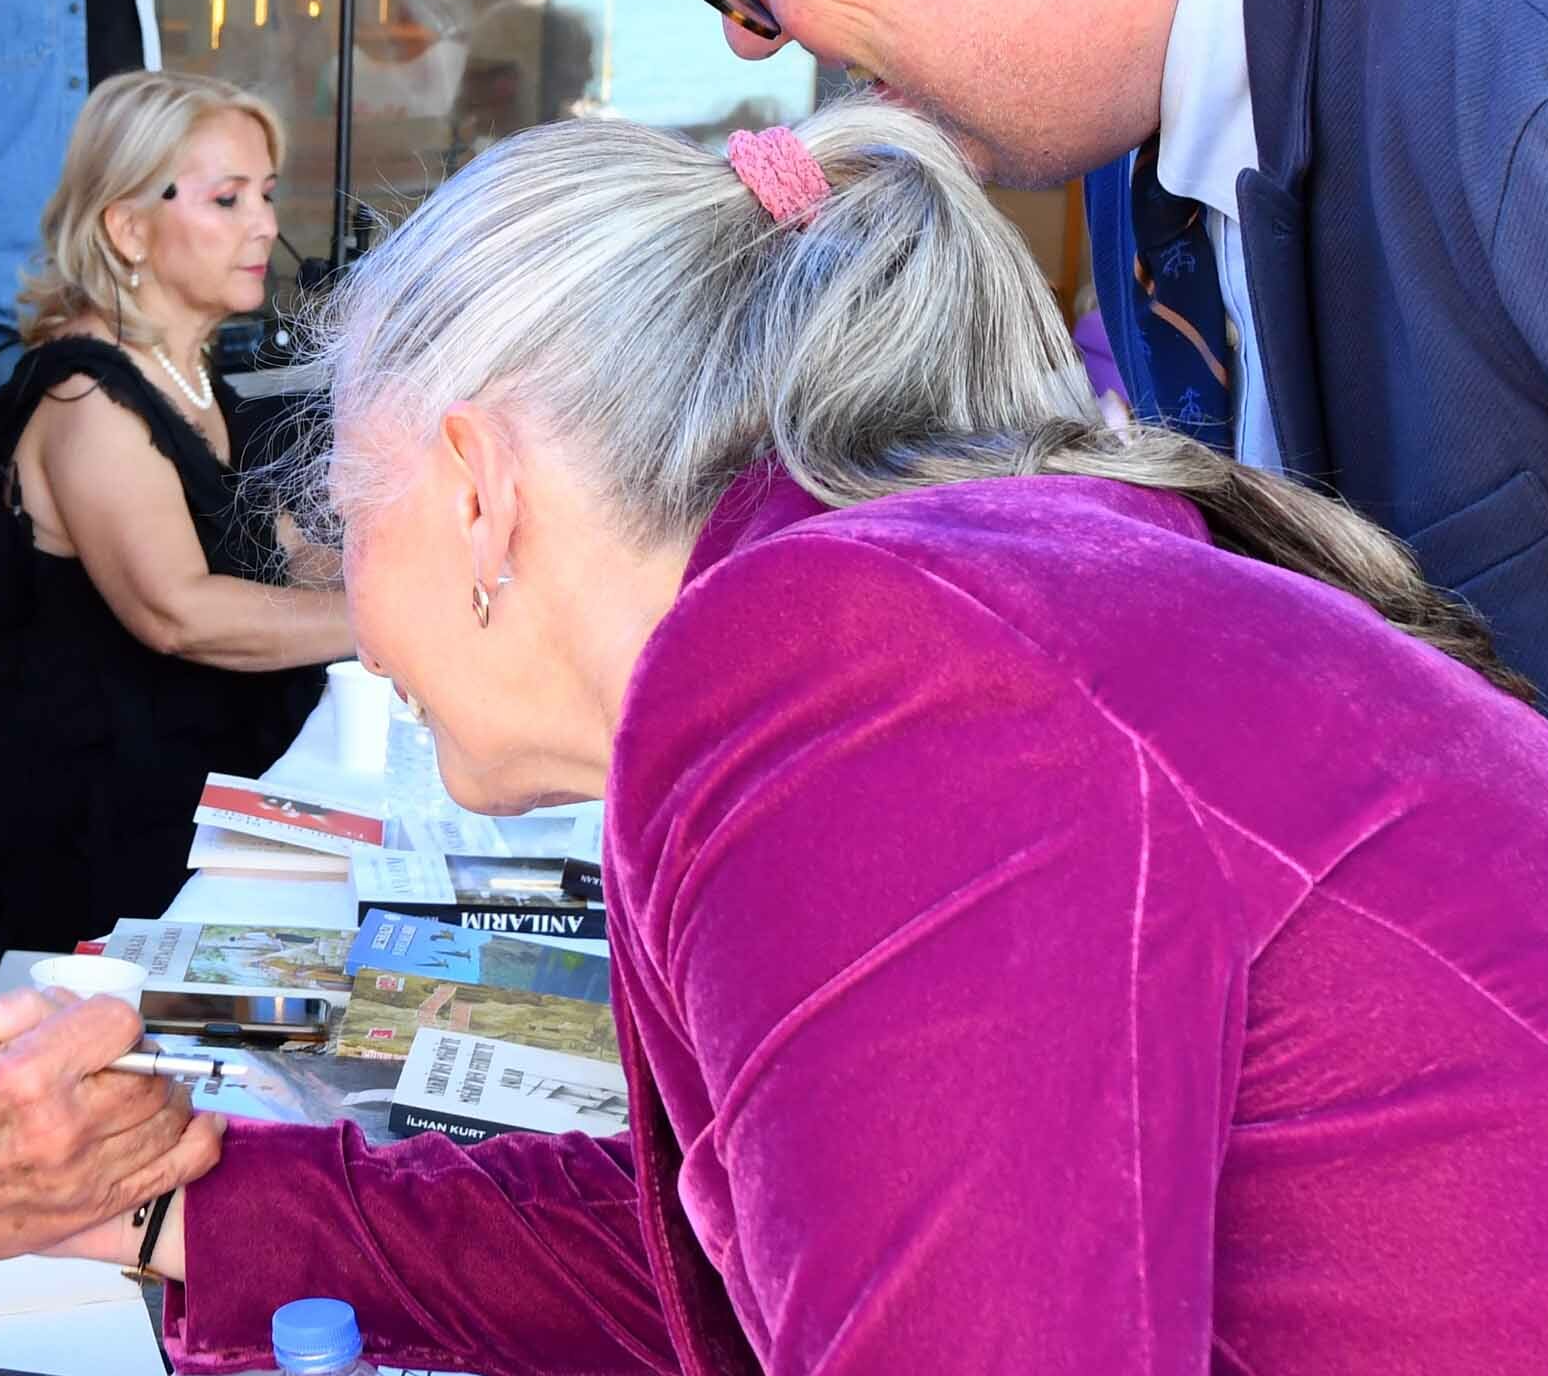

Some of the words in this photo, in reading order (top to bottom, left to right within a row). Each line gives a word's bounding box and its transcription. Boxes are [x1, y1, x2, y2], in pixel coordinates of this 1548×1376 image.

[461, 912, 584, 934] ANILARIM
[406, 1114, 447, 1132] İLHAN
[450, 1124, 486, 1139] KURT
